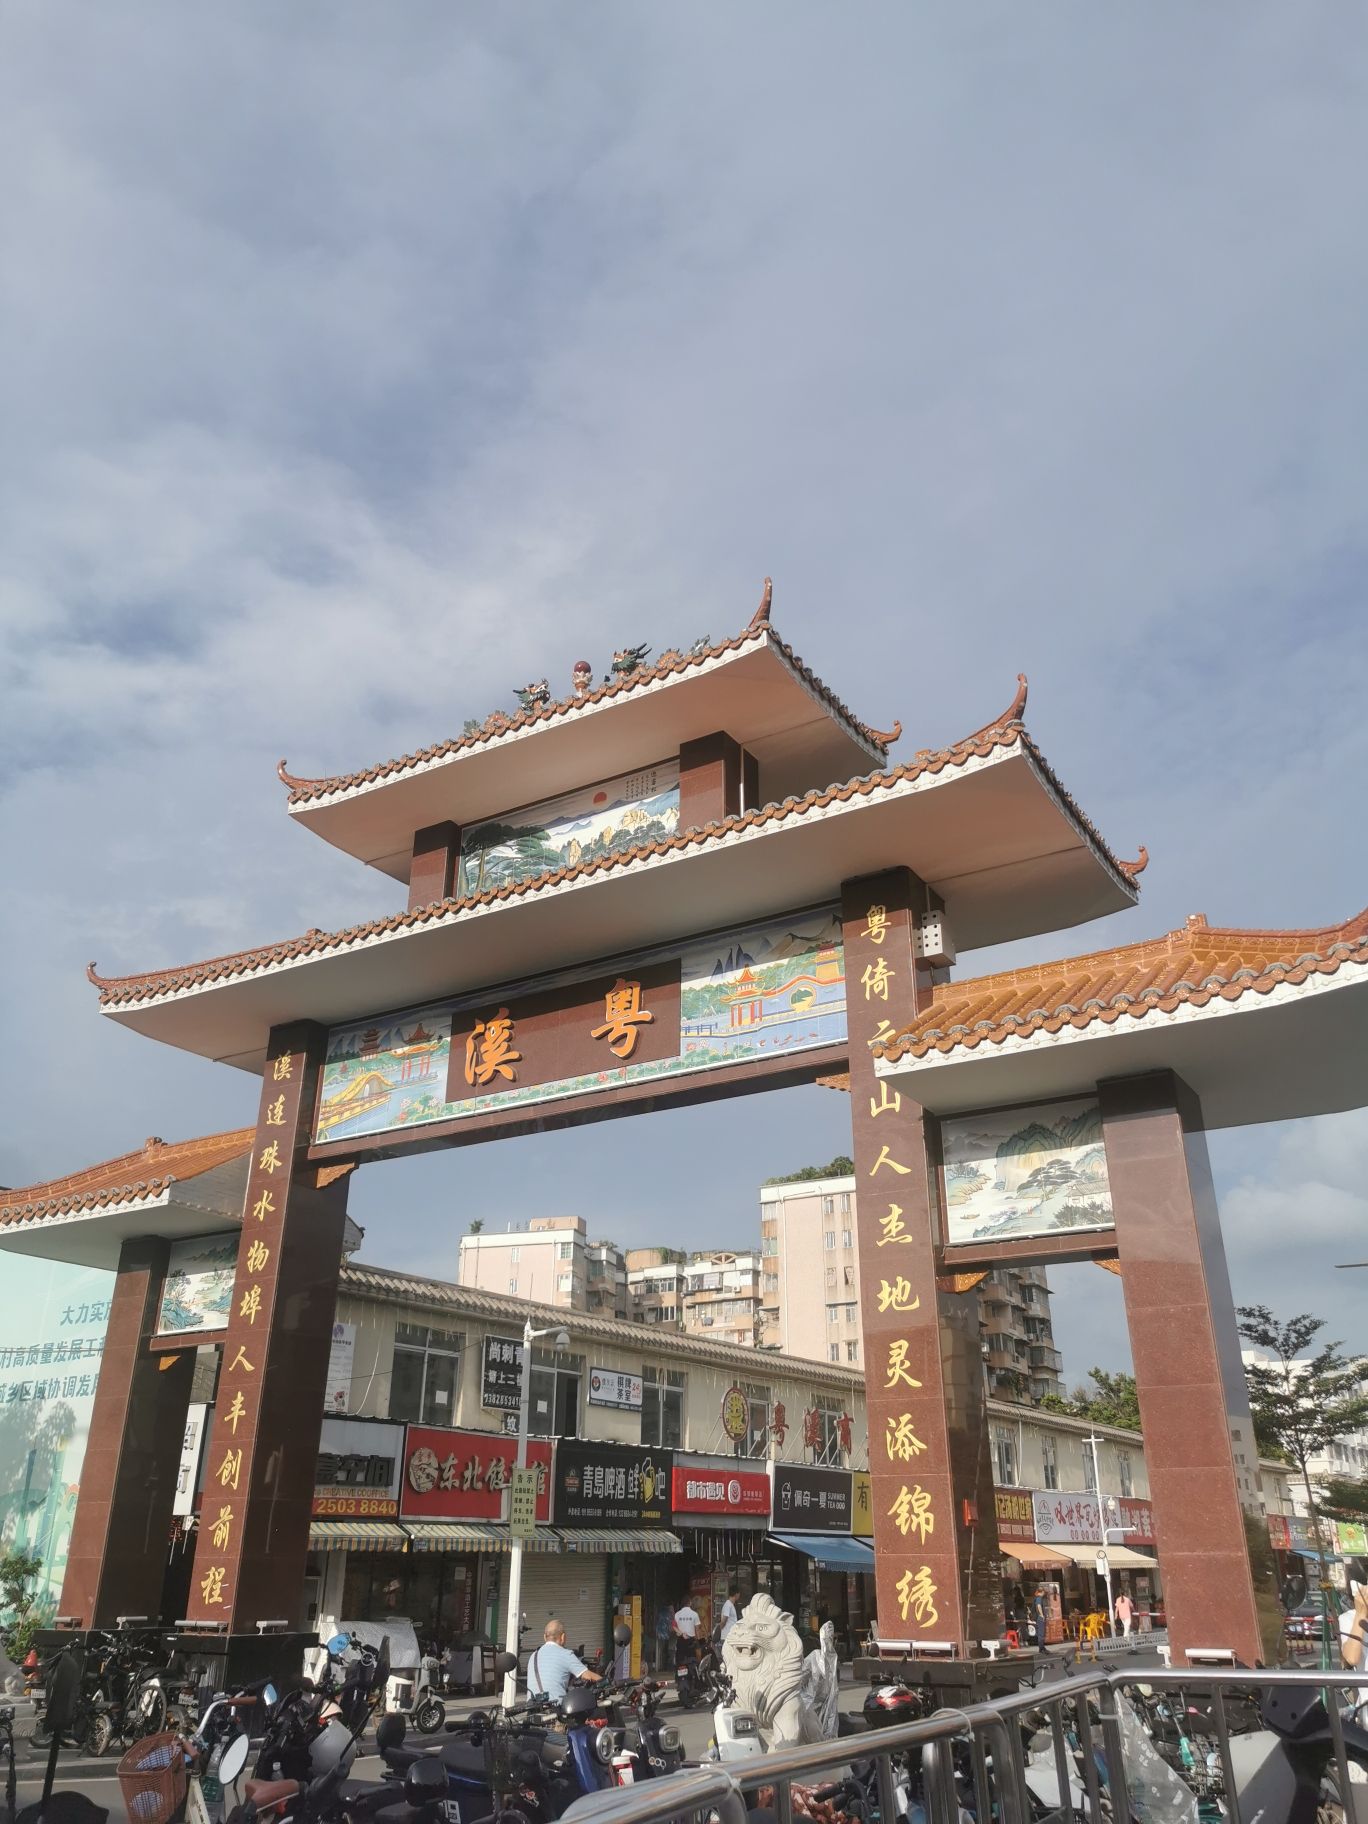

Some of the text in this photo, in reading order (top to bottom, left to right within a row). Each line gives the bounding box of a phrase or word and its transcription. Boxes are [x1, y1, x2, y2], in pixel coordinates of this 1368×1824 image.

[440, 1452, 549, 1494] 东北饺馆
[316, 1499, 397, 1514] 2503 8840
